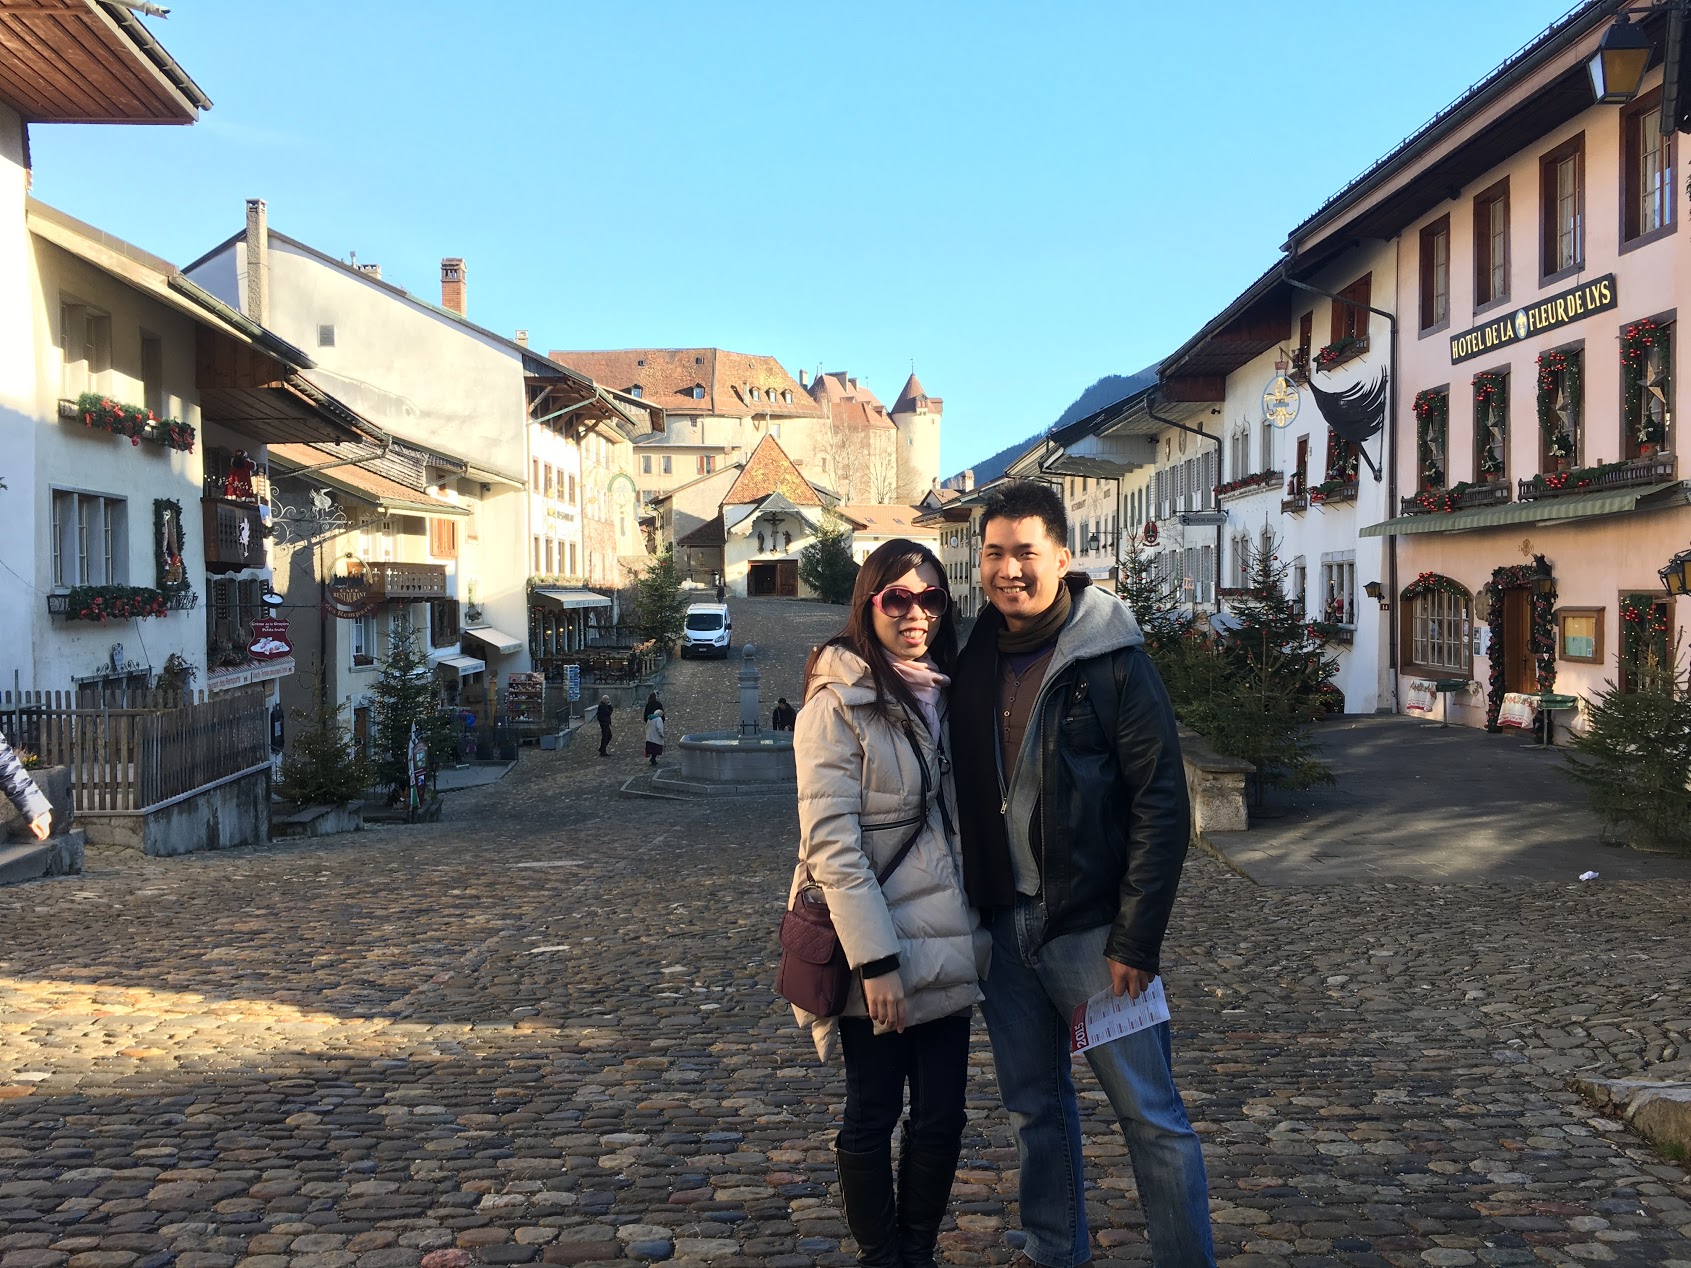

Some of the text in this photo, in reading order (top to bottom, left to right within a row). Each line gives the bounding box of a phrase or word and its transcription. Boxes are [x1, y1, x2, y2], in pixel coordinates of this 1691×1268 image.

[1452, 280, 1611, 359] HOTEL DE LA FLEUR DE LYS
[333, 591, 367, 603] RESTAURANT
[324, 603, 375, 618] des Remparts
[1074, 1022, 1087, 1049] 2015
